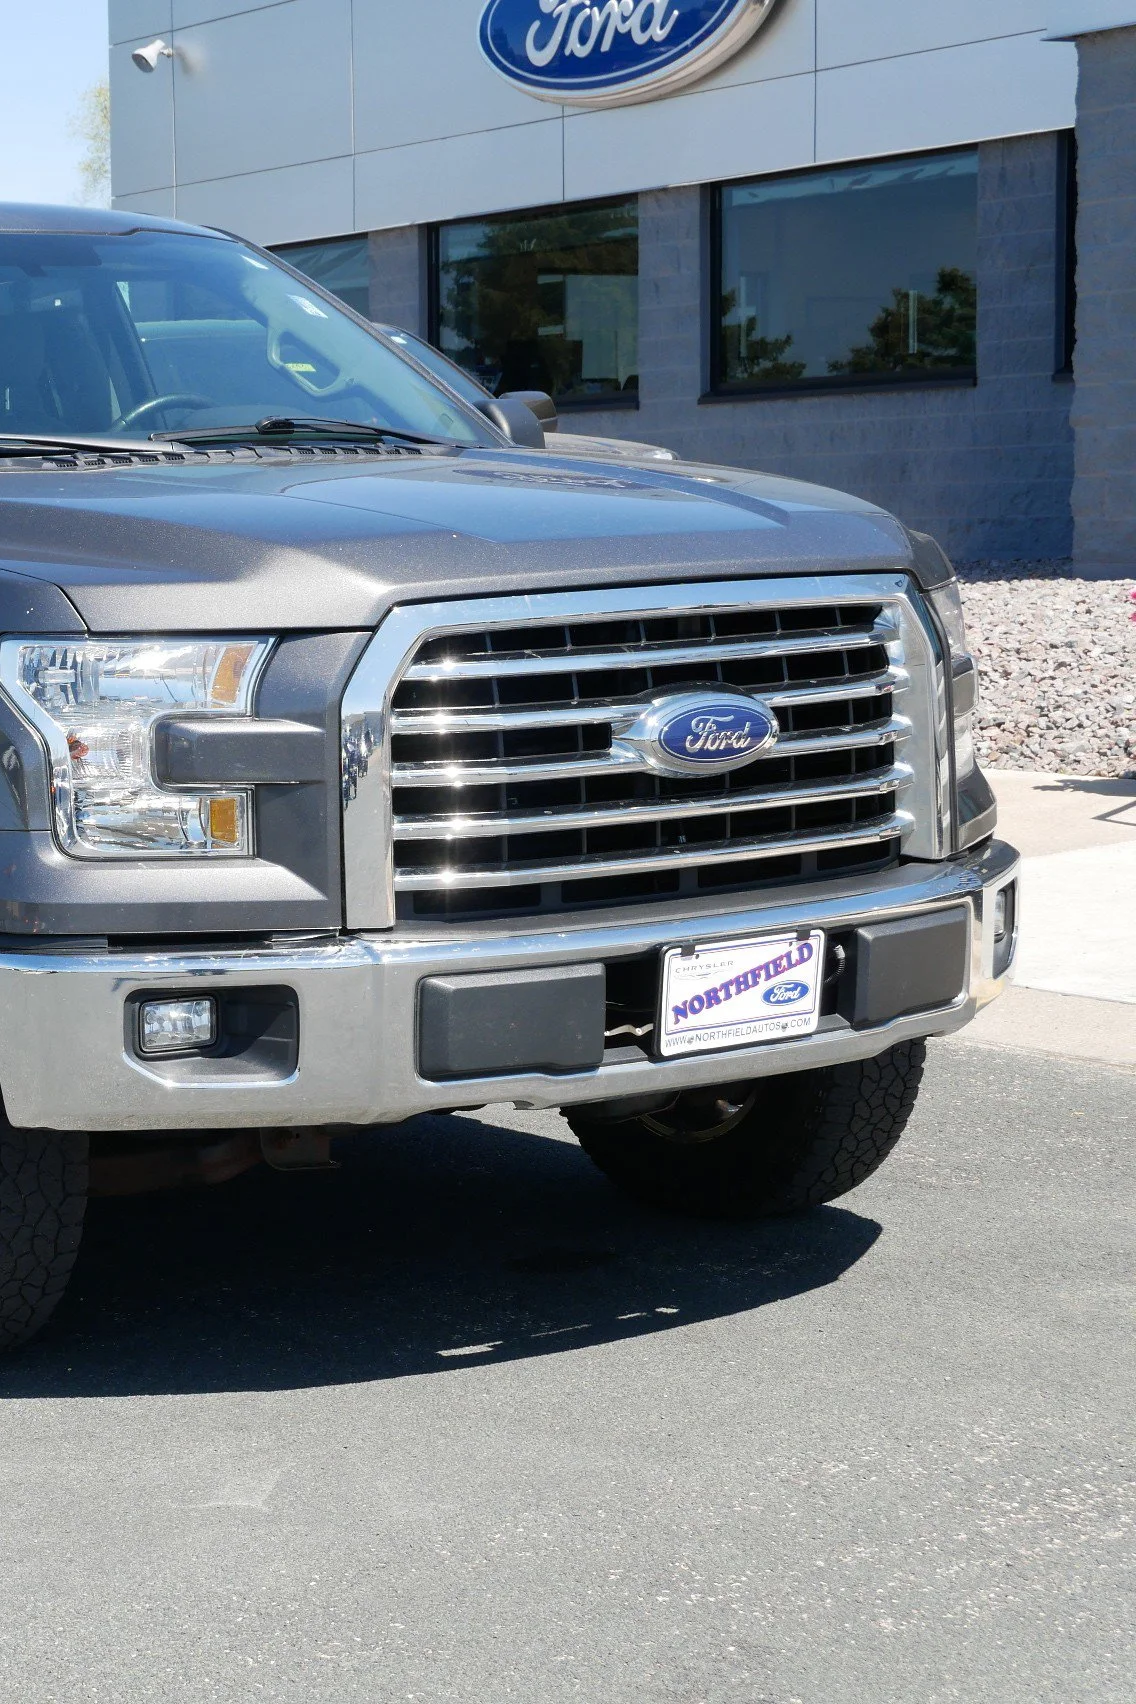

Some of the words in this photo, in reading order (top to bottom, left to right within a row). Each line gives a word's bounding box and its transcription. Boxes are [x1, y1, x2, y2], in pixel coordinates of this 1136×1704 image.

[525, 0, 679, 67] Ford
[686, 715, 751, 753] Ford
[671, 942, 814, 1025] NORTHFIELD
[675, 960, 734, 974] CHRYSLER
[769, 984, 801, 1003] Ford
[665, 1017, 811, 1048] WWWNORTHFIELDAUTOS.COM
